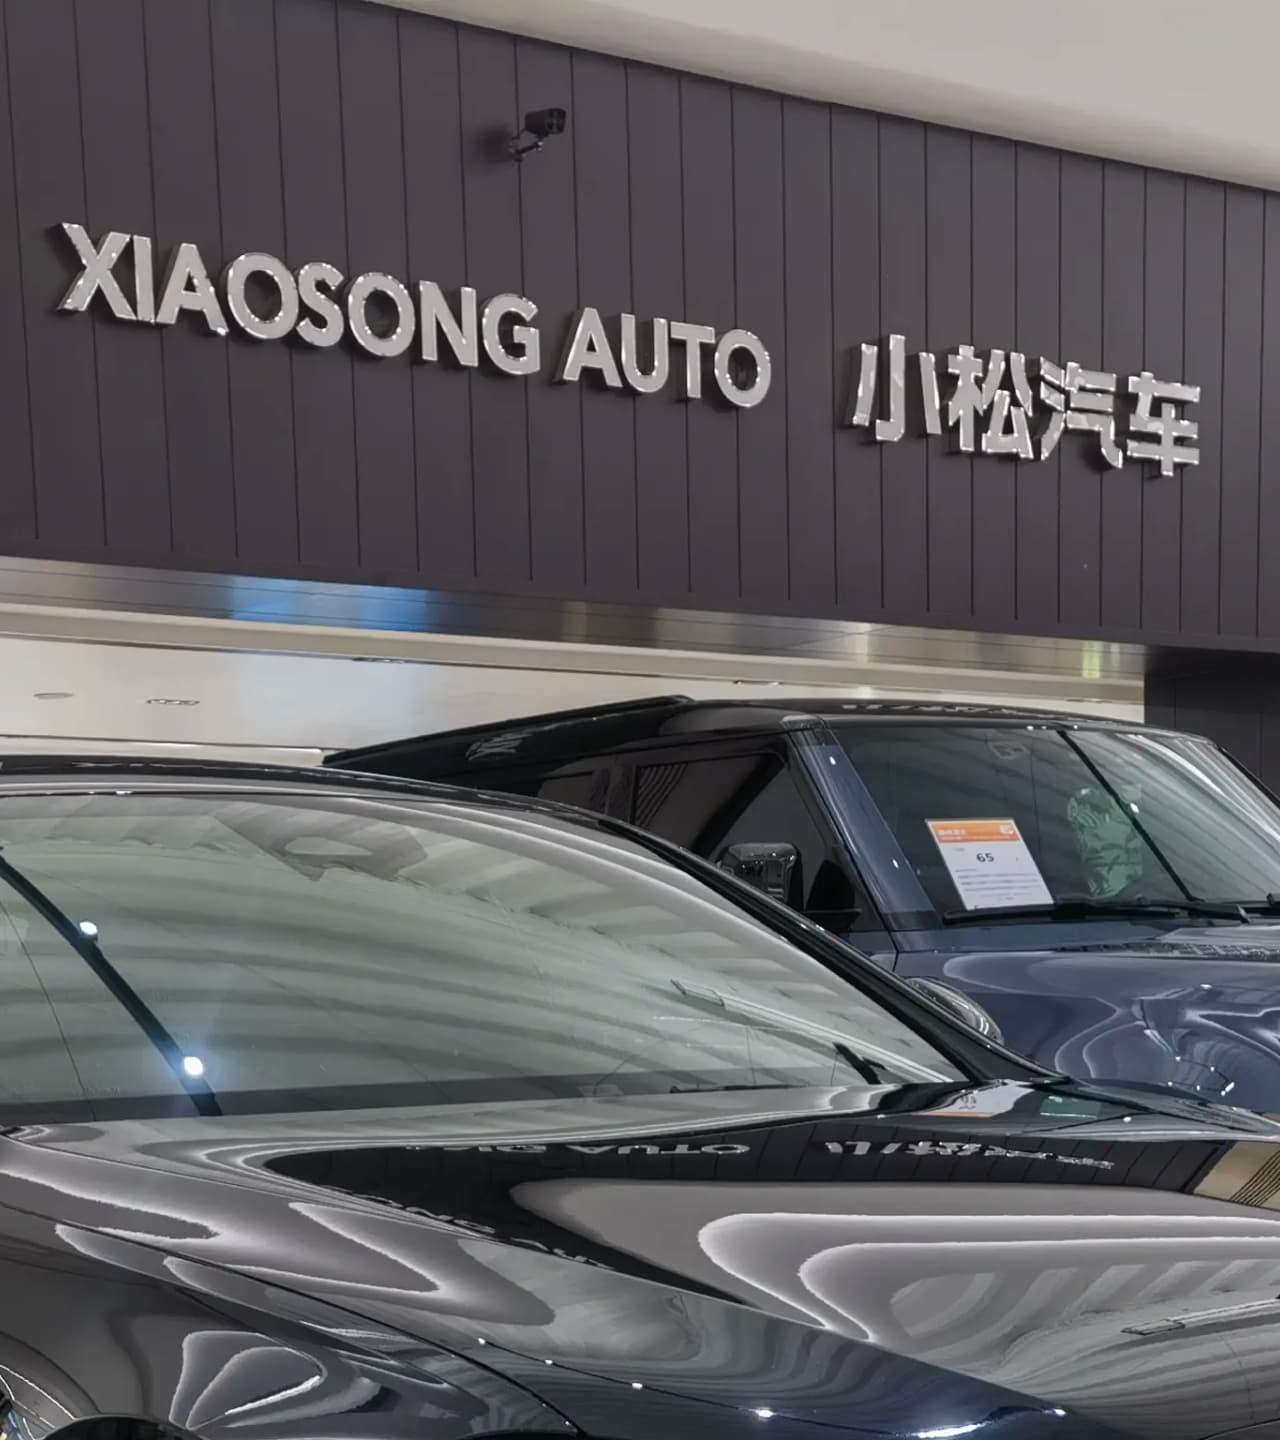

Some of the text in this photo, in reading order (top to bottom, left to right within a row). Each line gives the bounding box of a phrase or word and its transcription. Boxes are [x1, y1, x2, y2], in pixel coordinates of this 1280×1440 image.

[56, 221, 772, 408] XIAOSONG AUTO
[850, 333, 1201, 477] 小松汽车
[976, 852, 995, 863] 65
